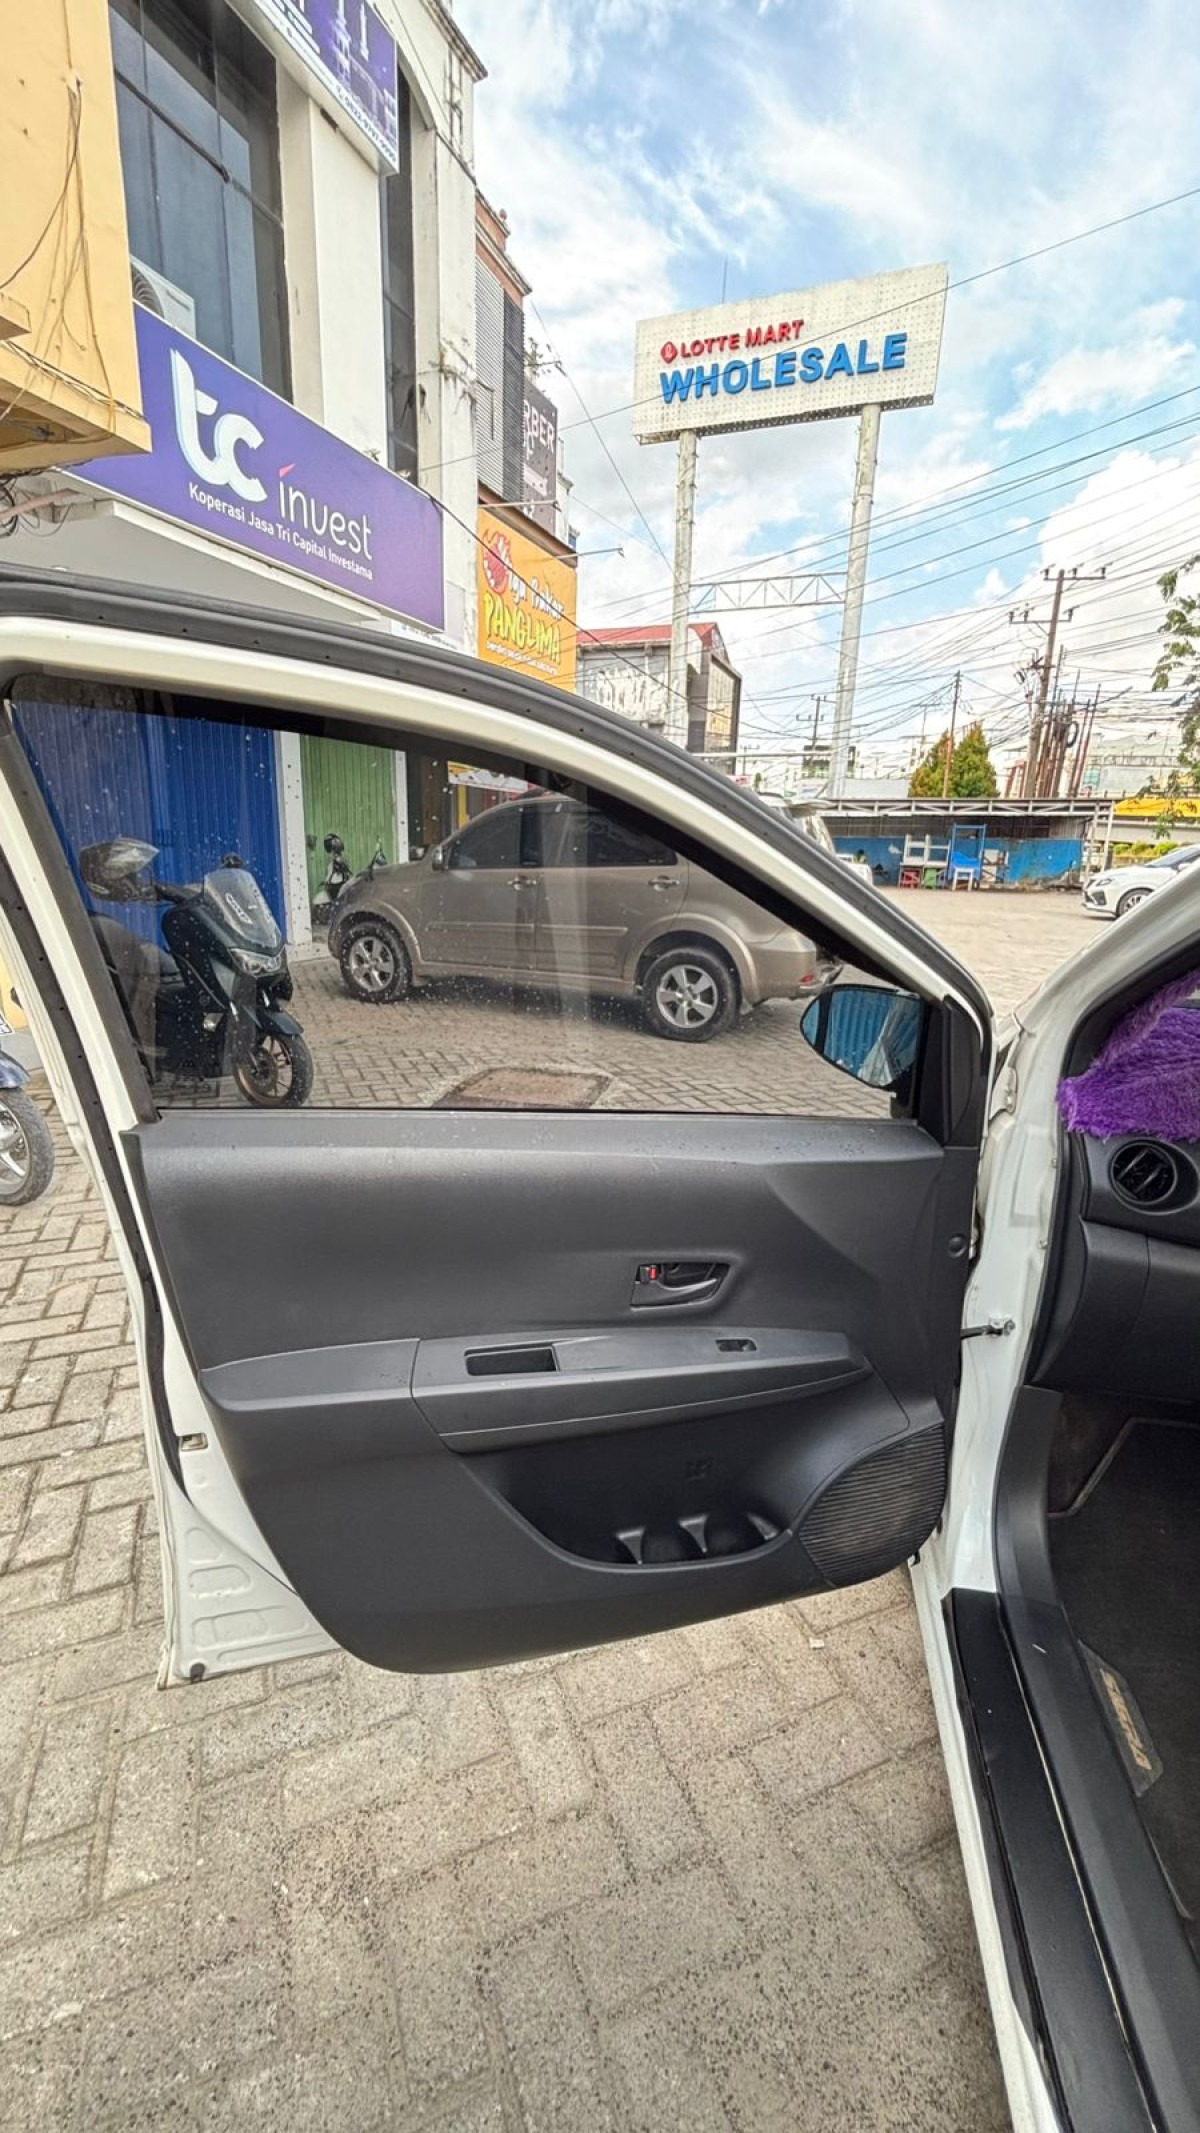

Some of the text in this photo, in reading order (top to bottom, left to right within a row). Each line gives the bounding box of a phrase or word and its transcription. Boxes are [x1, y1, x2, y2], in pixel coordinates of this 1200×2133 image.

[659, 332, 908, 404] WHOLESALE
[681, 319, 804, 358] LOTTE MART
[189, 481, 373, 581] Koperasi Jasa Tri Capital Investama
[484, 591, 561, 665] PANGLIMA
